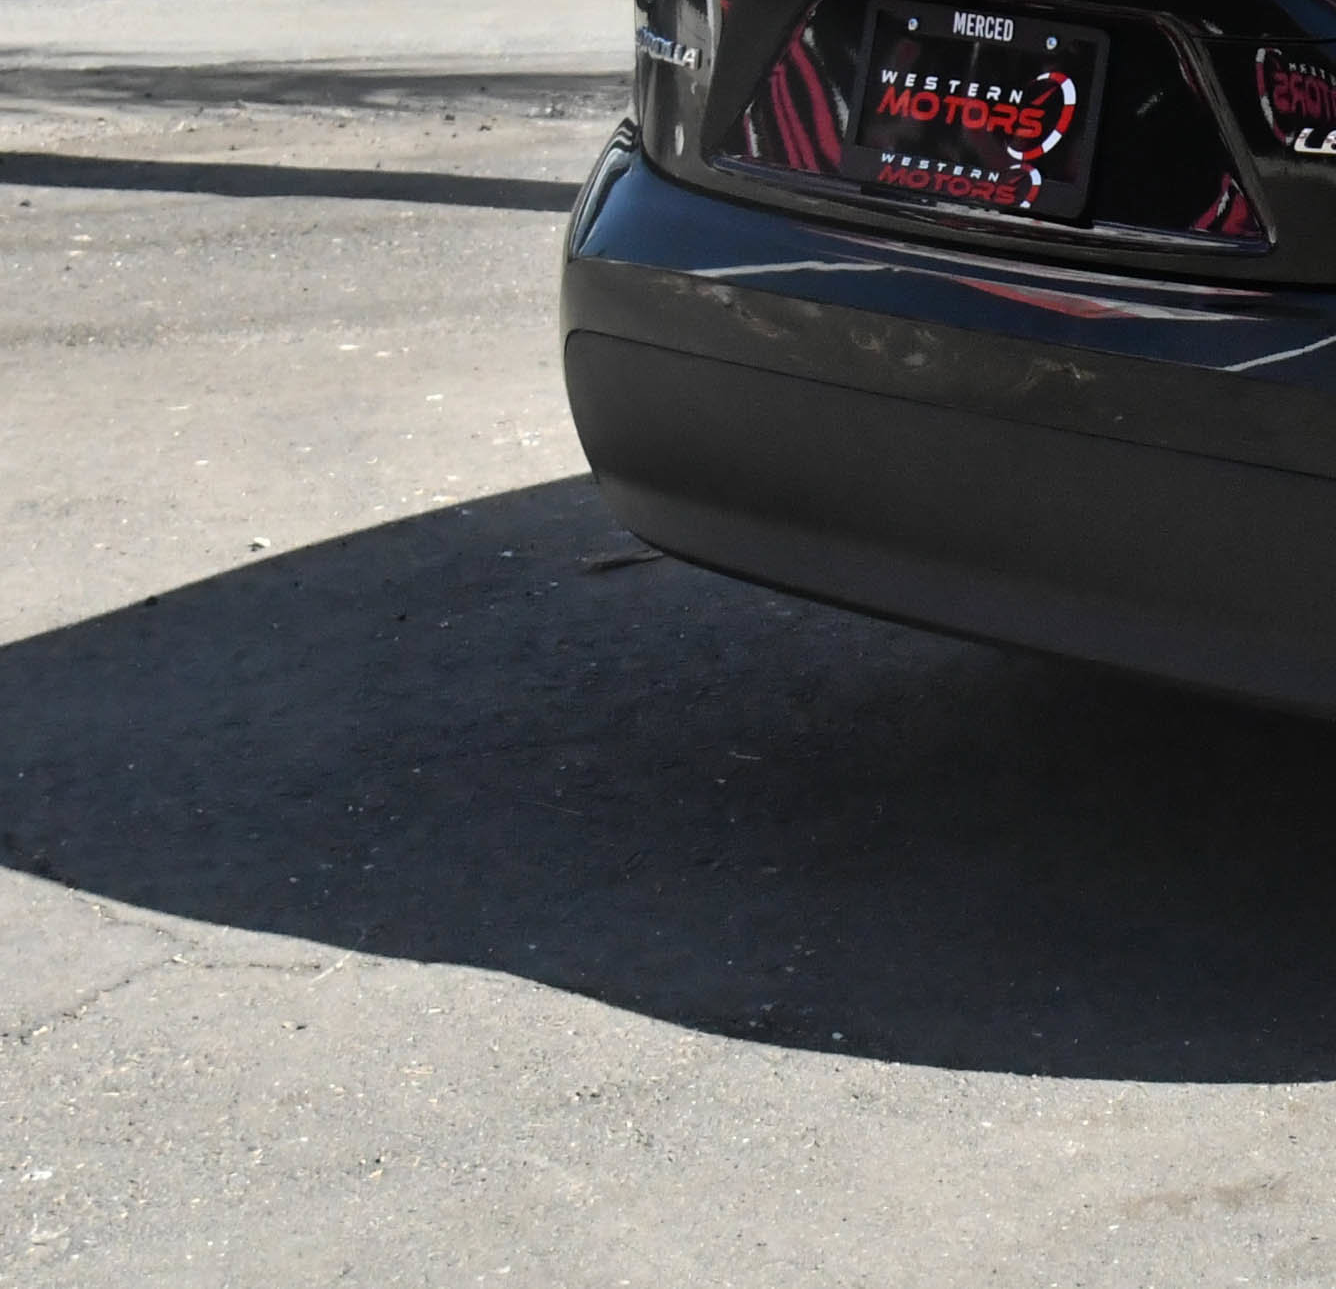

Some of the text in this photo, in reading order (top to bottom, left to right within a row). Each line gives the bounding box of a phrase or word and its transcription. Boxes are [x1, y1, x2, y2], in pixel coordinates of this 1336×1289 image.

[953, 11, 1014, 42] MERCED
[881, 69, 1023, 104] WESTERN
[876, 86, 1046, 138] MOTORS
[879, 165, 1016, 204] MOTORS
[881, 152, 1000, 182] WESTERN
